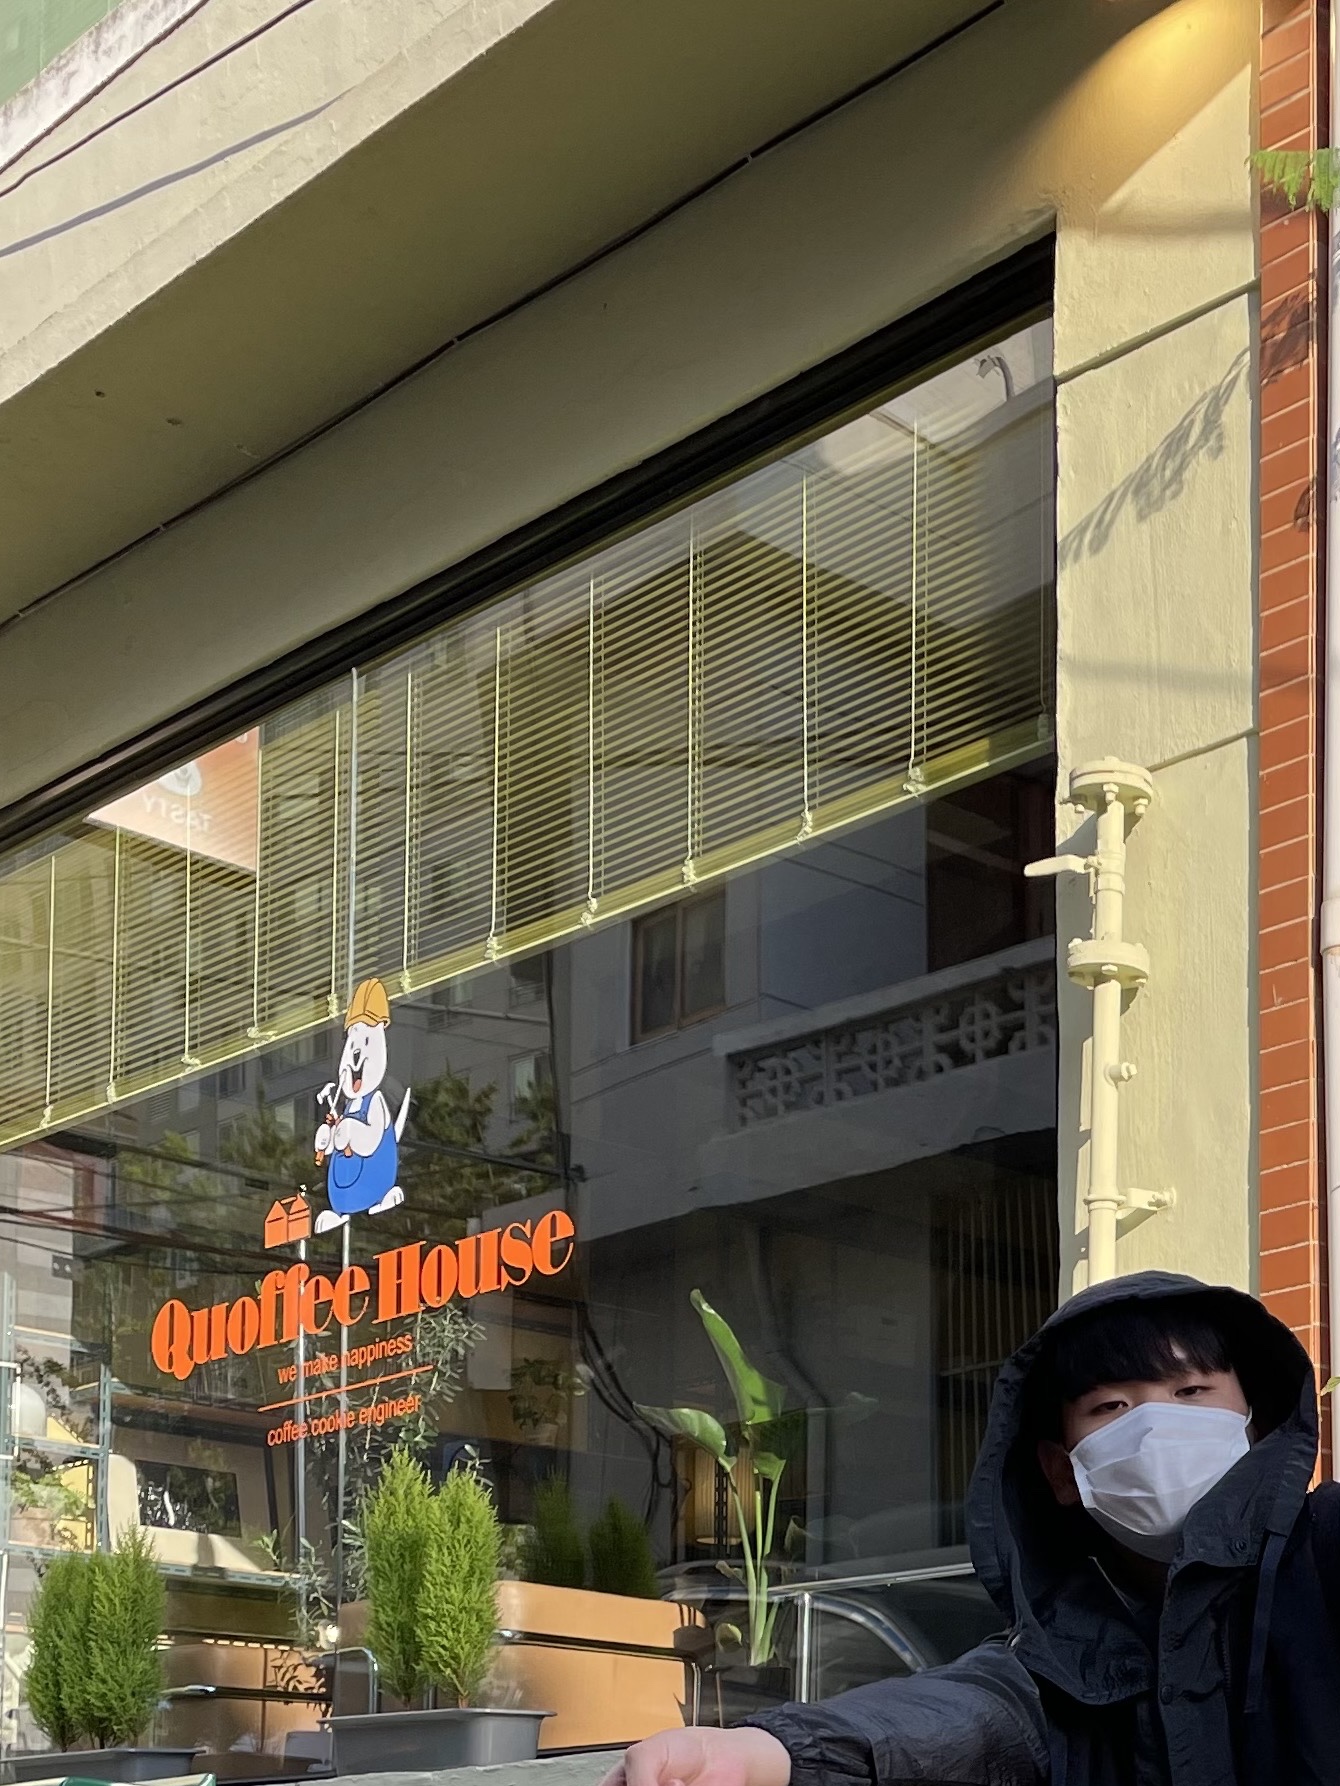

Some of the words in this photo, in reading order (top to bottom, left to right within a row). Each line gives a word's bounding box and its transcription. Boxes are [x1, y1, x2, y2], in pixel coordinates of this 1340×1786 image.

[152, 1263, 371, 1380] Quoffee
[373, 1210, 575, 1325] House
[277, 1365, 298, 1385] we
[303, 1352, 338, 1378] make
[267, 1418, 309, 1447] coffee
[311, 1408, 355, 1436] cookie
[359, 1392, 422, 1427] engineer
